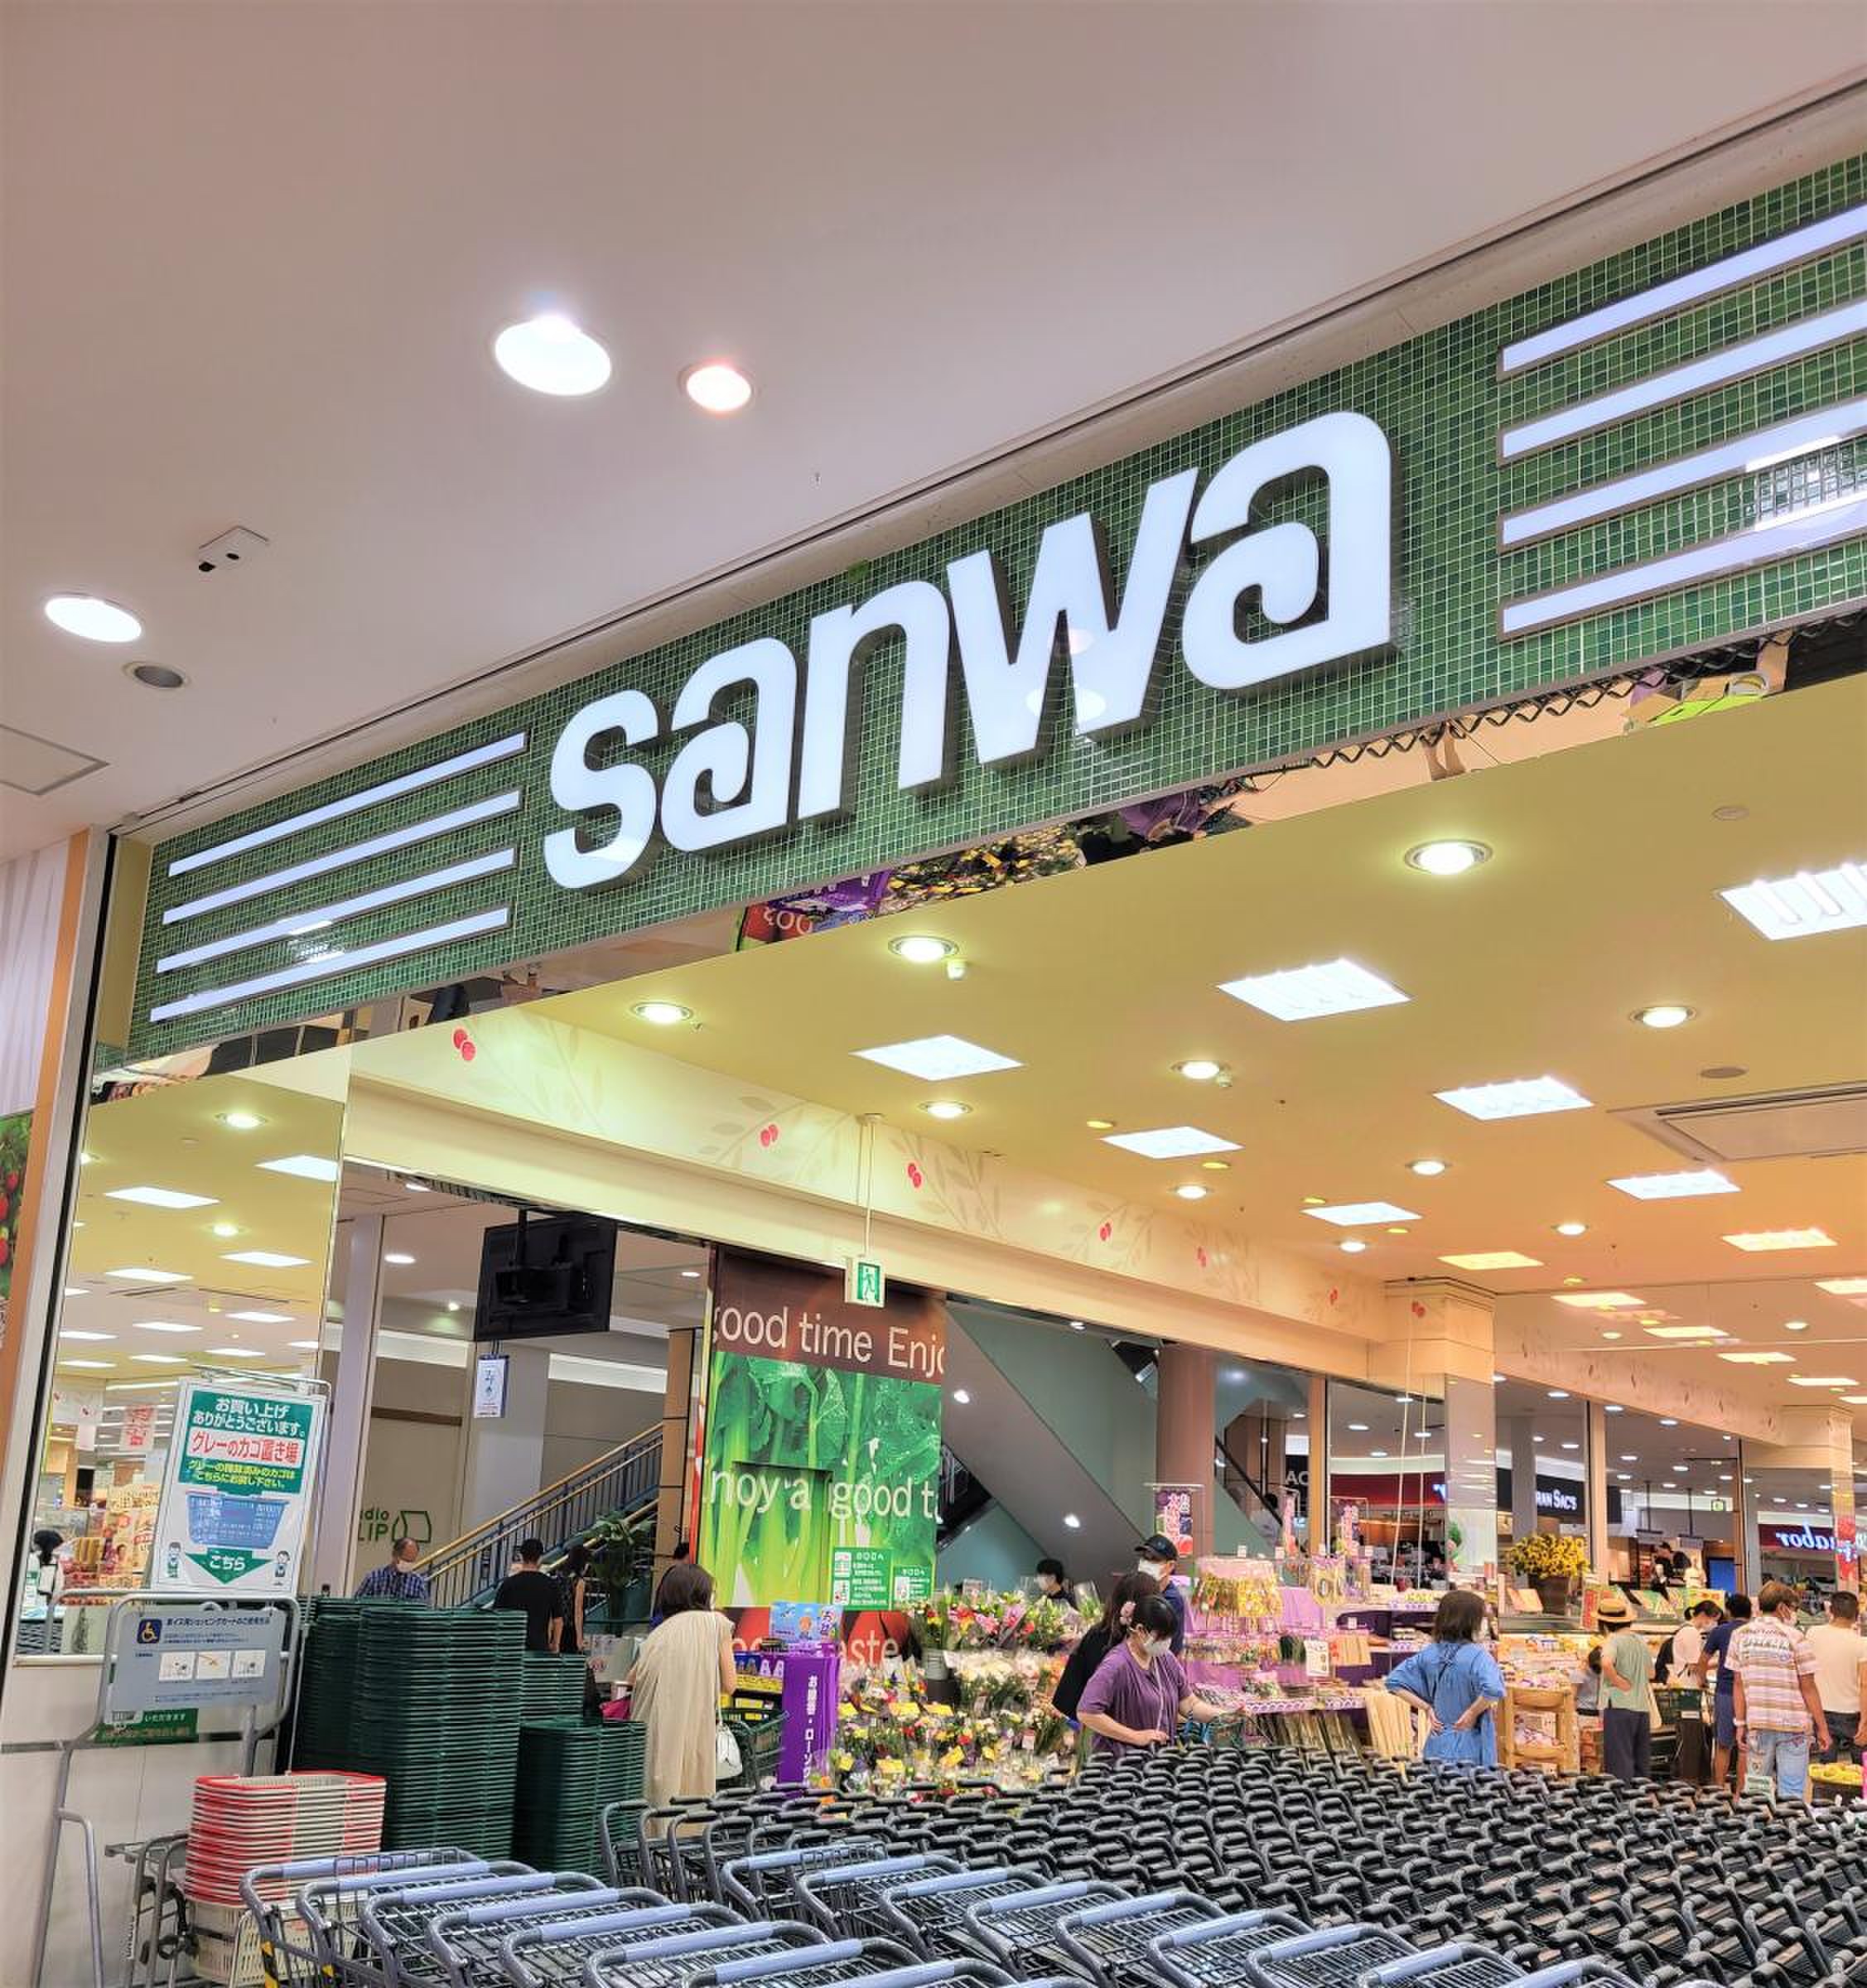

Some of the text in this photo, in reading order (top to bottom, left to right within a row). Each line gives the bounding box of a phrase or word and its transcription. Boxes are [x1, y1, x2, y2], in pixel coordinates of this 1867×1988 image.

[543, 410, 1393, 890] sanwa
[799, 1312, 872, 1363] time
[192, 1410, 306, 1437] ありがとうございます。
[215, 1397, 291, 1419] お買い上げ
[191, 1431, 299, 1464] グレーのカゴ置き場
[832, 1477, 912, 1519] good
[210, 1555, 247, 1571] こちら
